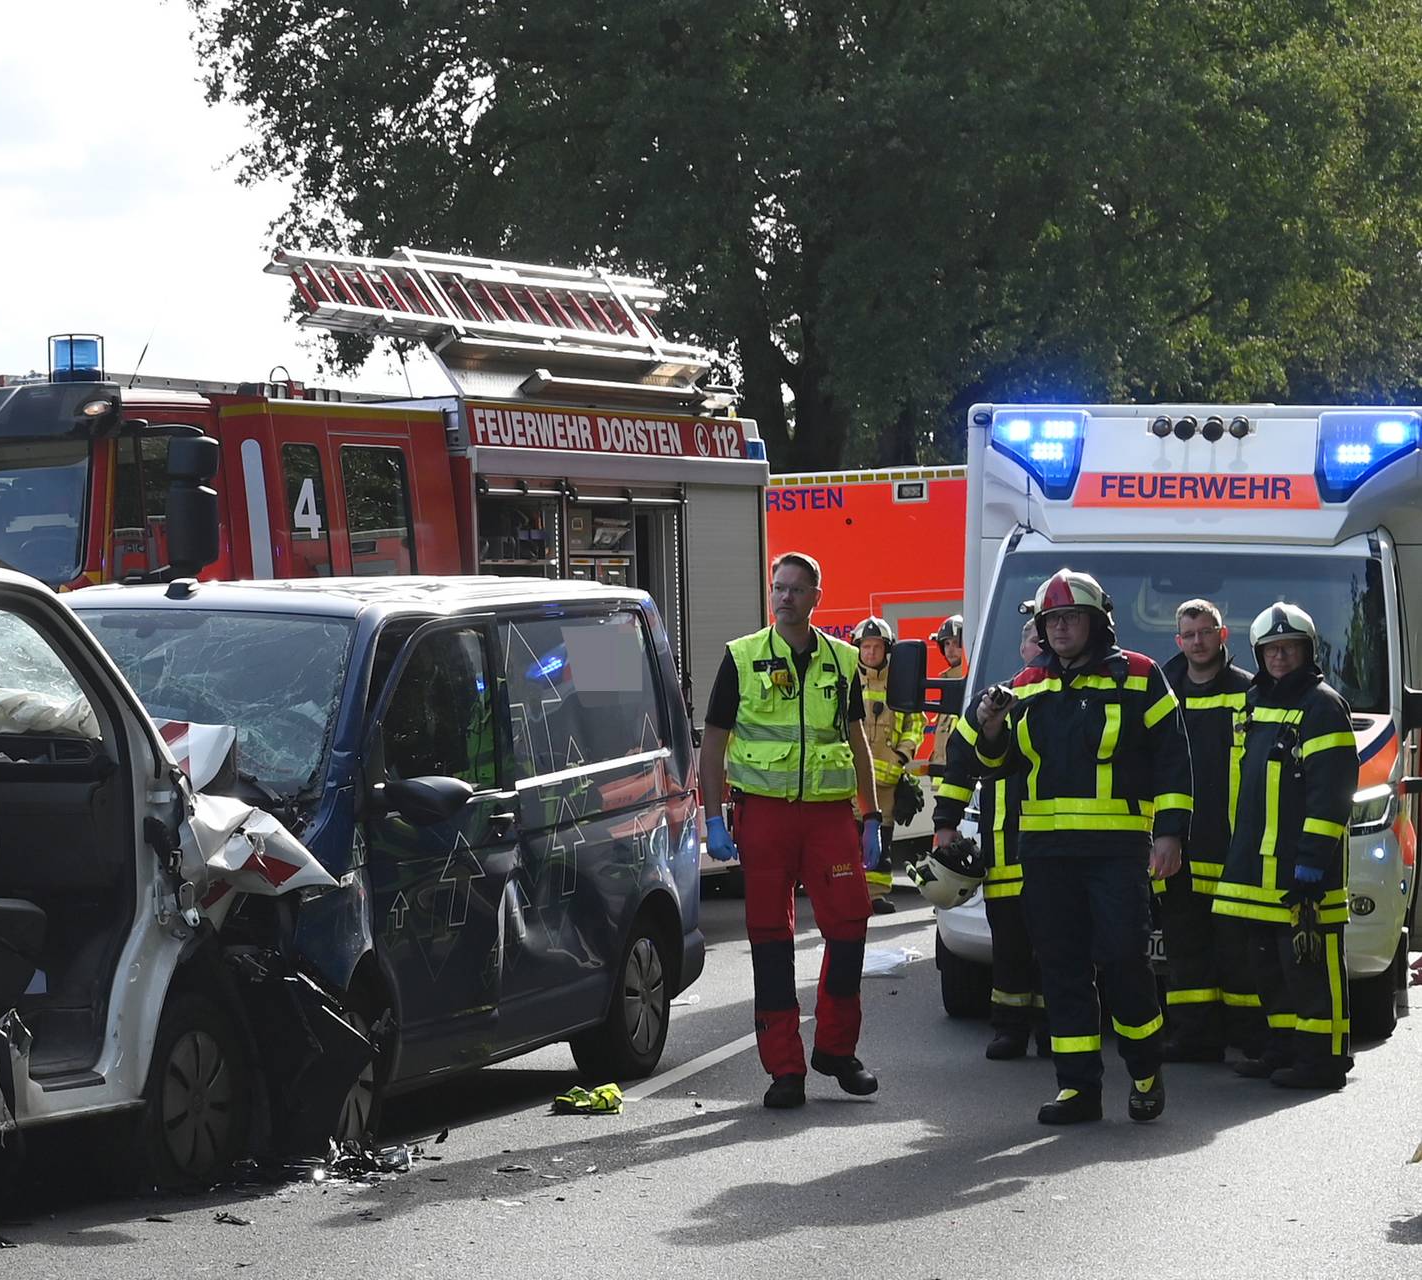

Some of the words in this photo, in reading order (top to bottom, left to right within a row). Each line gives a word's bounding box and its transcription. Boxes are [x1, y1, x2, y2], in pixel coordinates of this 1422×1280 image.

[473, 408, 594, 450] FEUERWEHR
[596, 417, 683, 455] DORSTEN
[712, 425, 740, 458] 112
[765, 487, 843, 512] RSTEN
[1100, 475, 1291, 500] FEUERWEHR
[294, 479, 322, 539] 4
